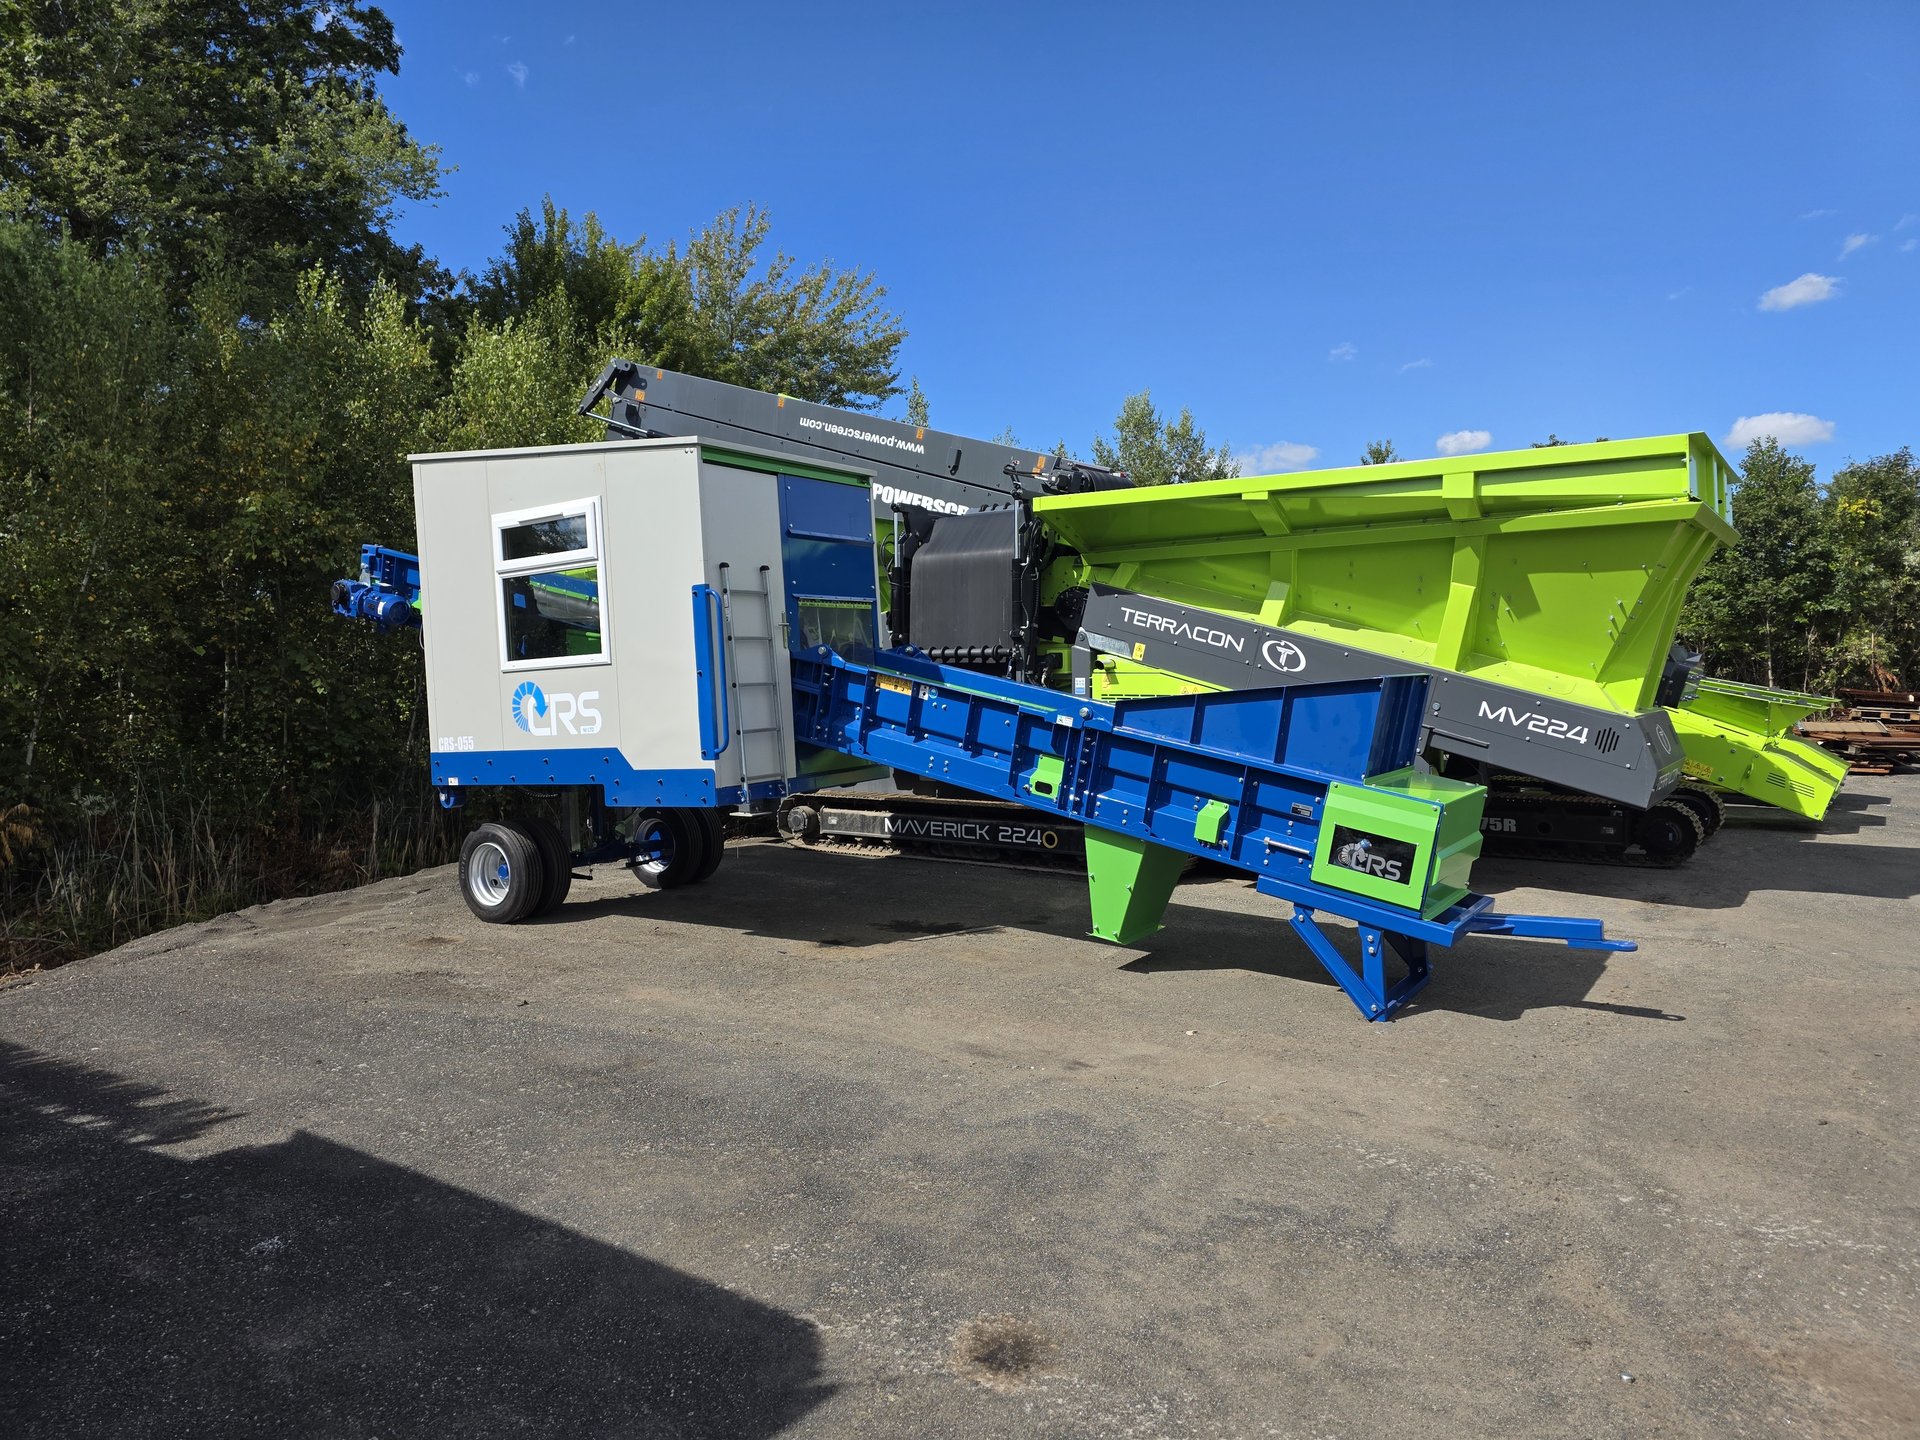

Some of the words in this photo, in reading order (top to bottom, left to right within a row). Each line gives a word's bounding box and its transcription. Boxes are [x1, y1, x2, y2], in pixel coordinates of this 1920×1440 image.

[799, 416, 925, 455] www.powerscreen.com
[1120, 606, 1245, 653] TERRACON
[527, 690, 603, 737] CRS
[1477, 700, 1589, 745] MV224
[438, 735, 474, 751] CRS-055
[884, 817, 990, 841] MAVERICK
[998, 825, 1059, 849] 2240
[1480, 816, 1517, 833] 75R
[1350, 851, 1403, 881] CRS
